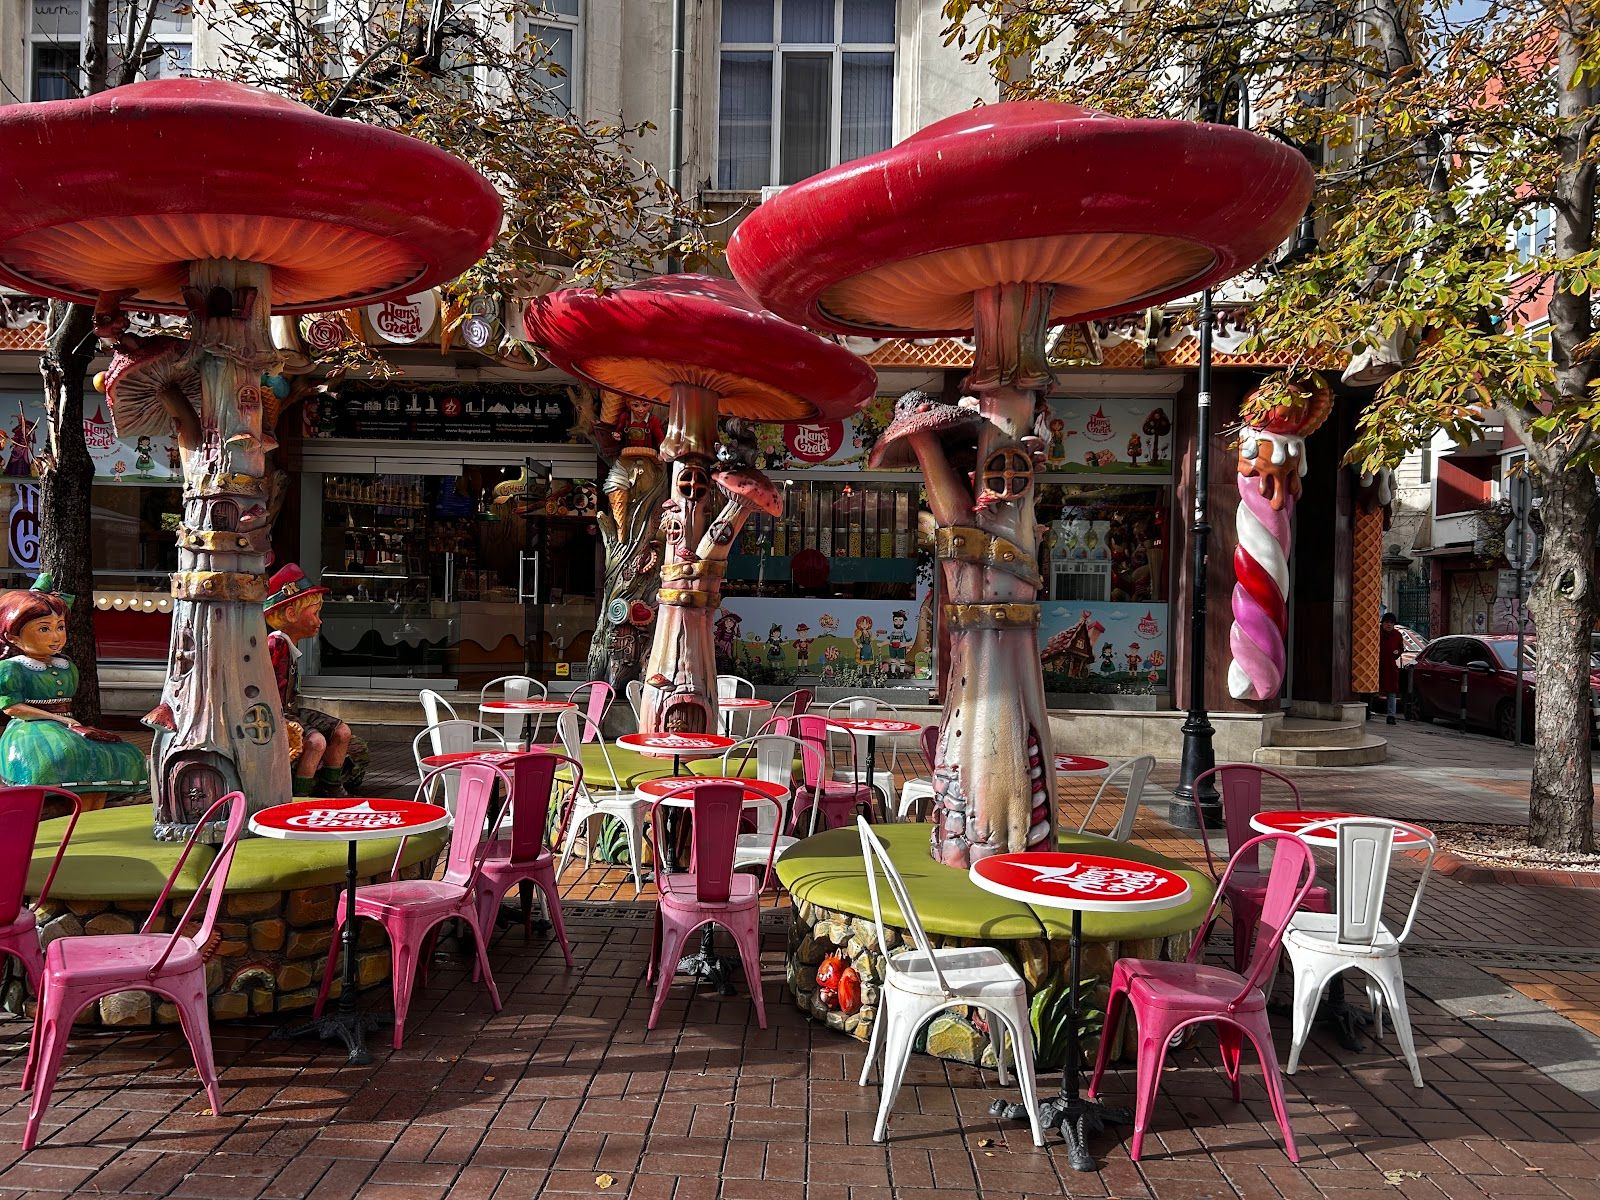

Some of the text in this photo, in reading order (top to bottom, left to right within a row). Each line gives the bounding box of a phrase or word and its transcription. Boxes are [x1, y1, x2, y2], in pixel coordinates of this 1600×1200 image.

[383, 301, 417, 322] Hans
[377, 310, 423, 334] Gretel
[794, 435, 831, 453] Gretel
[797, 426, 828, 444] Hans
[308, 809, 396, 823] Hans
